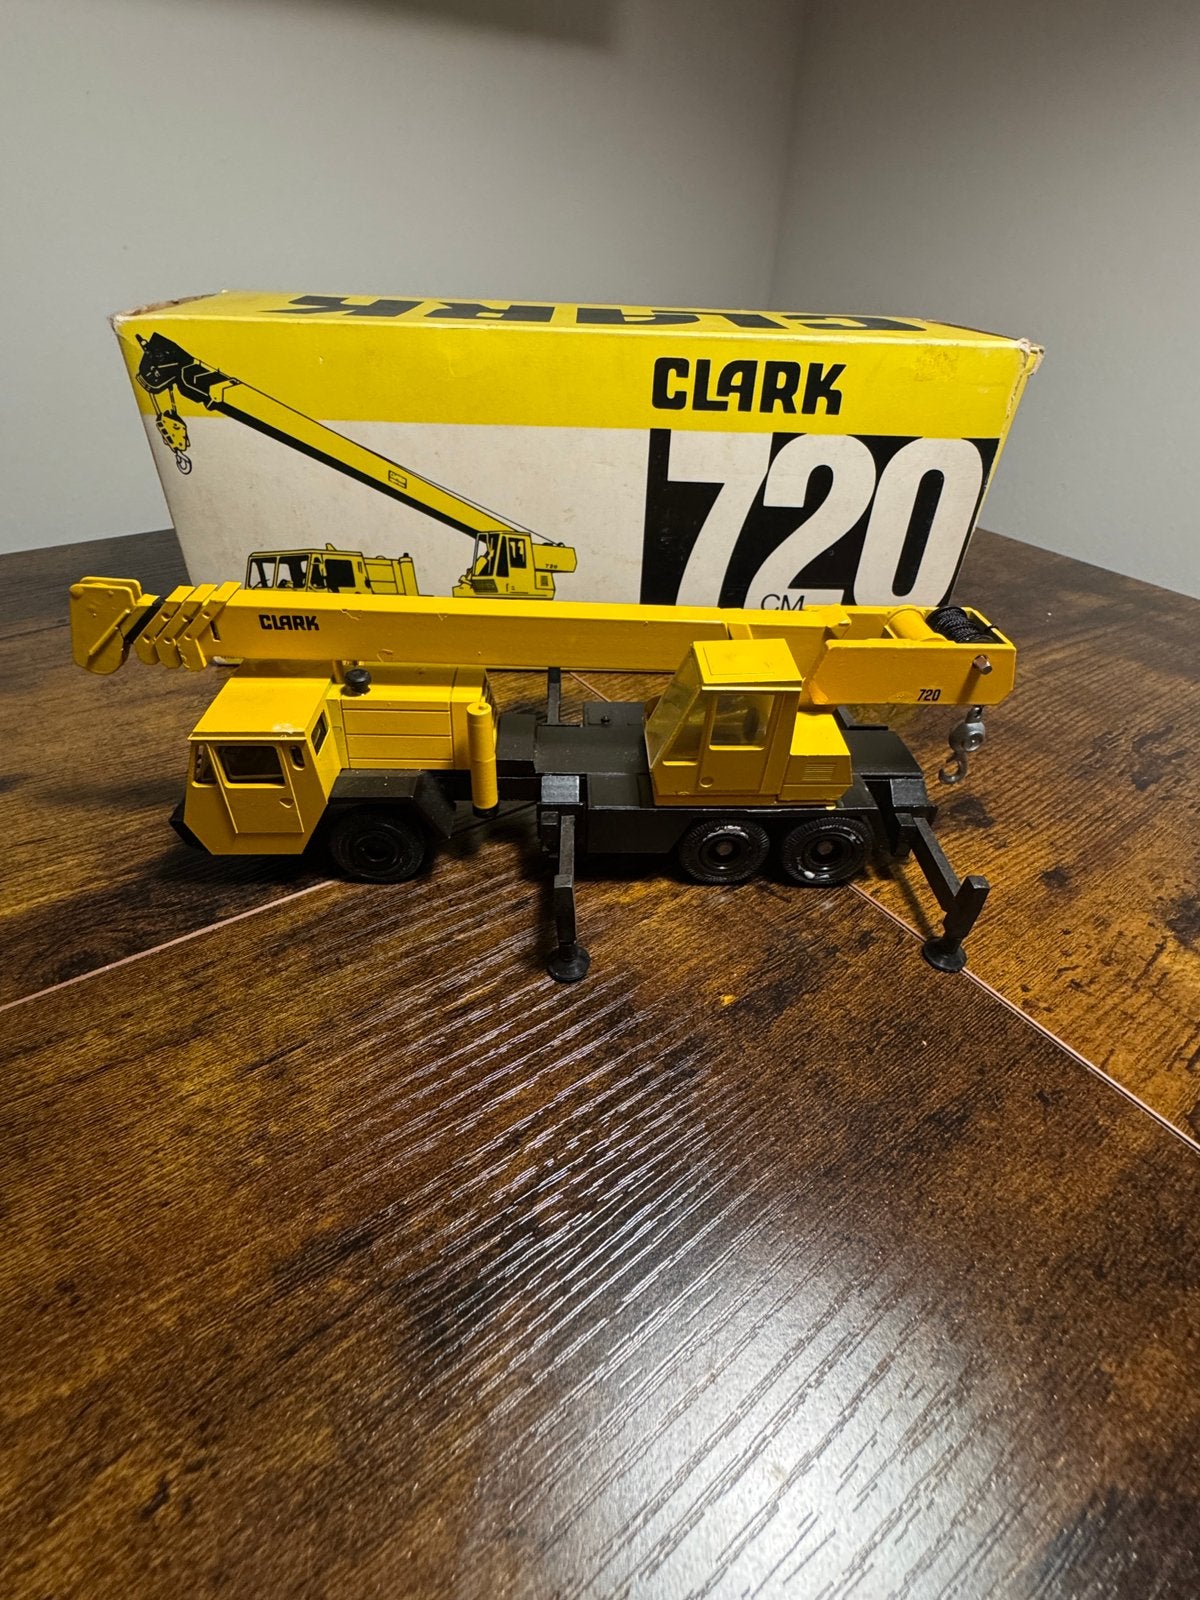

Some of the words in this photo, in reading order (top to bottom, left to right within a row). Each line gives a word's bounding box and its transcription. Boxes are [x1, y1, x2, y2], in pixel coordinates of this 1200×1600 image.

[266, 295, 927, 331] CLARK
[652, 357, 846, 416] CLARK
[667, 429, 984, 608] 720
[761, 593, 805, 611] CM
[258, 614, 320, 631] CLARK
[917, 688, 942, 702] 720
